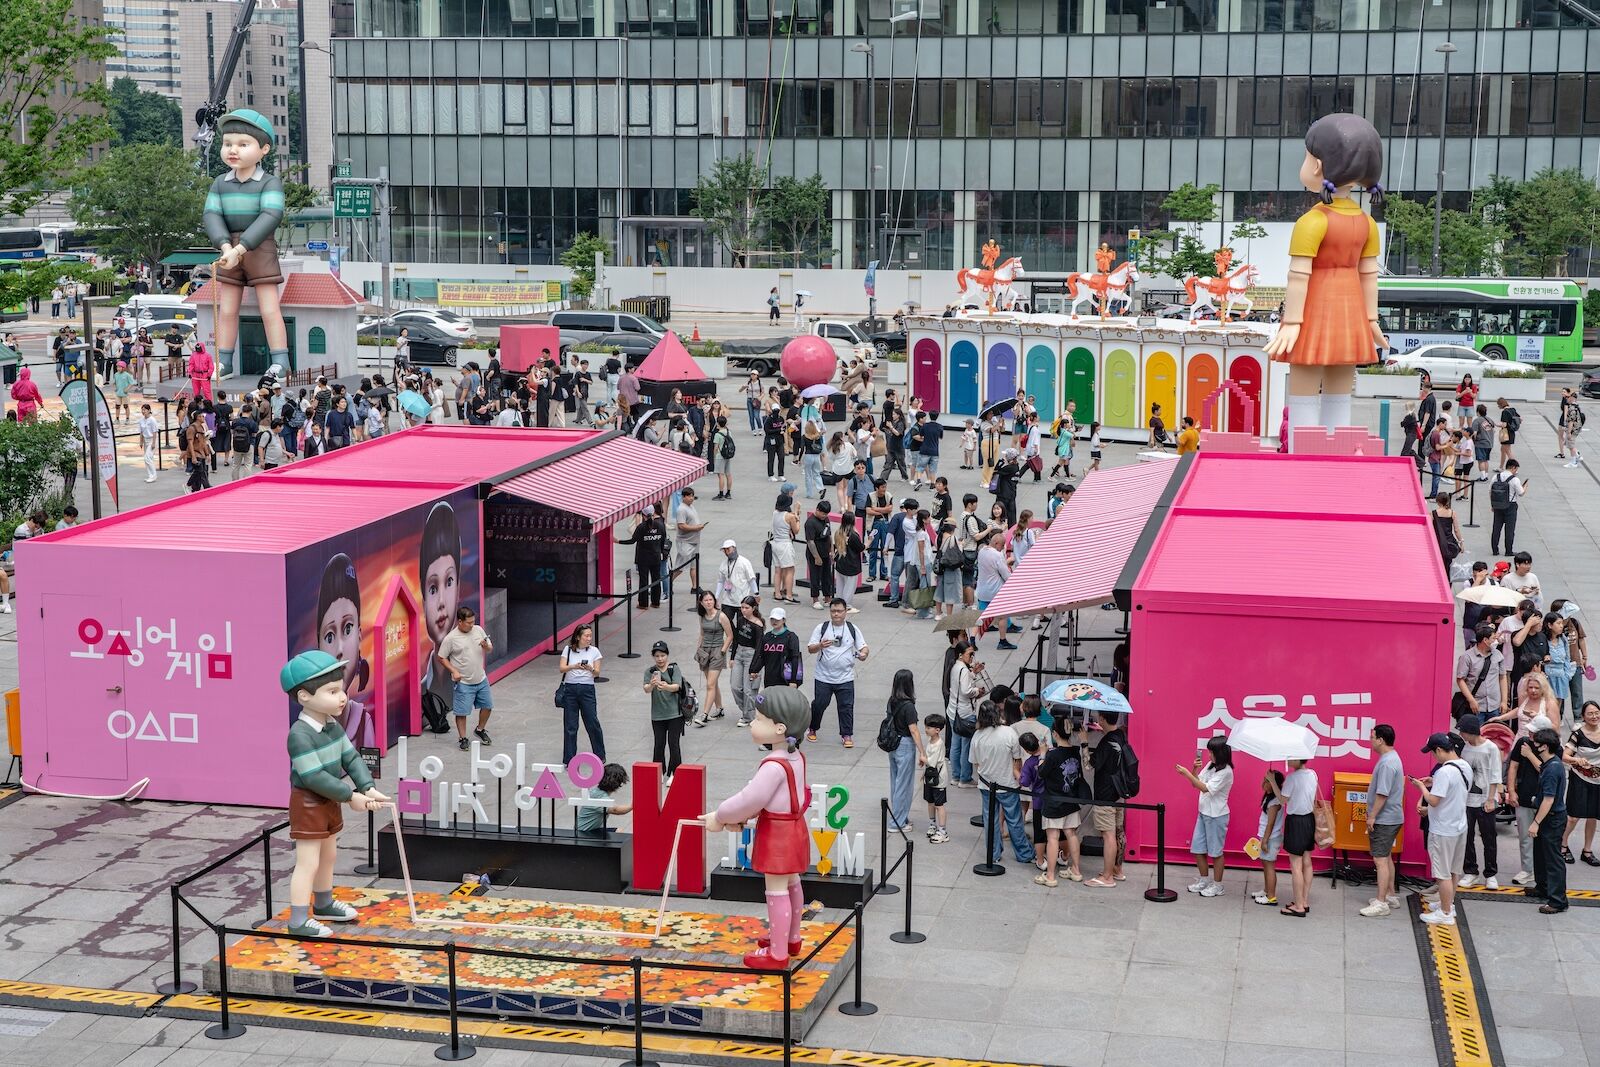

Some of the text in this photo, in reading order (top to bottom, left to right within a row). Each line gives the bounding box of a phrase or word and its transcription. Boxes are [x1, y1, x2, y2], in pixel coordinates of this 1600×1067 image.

[1513, 286, 1559, 295] 친환경 전기버스
[643, 534, 662, 542] STAFF
